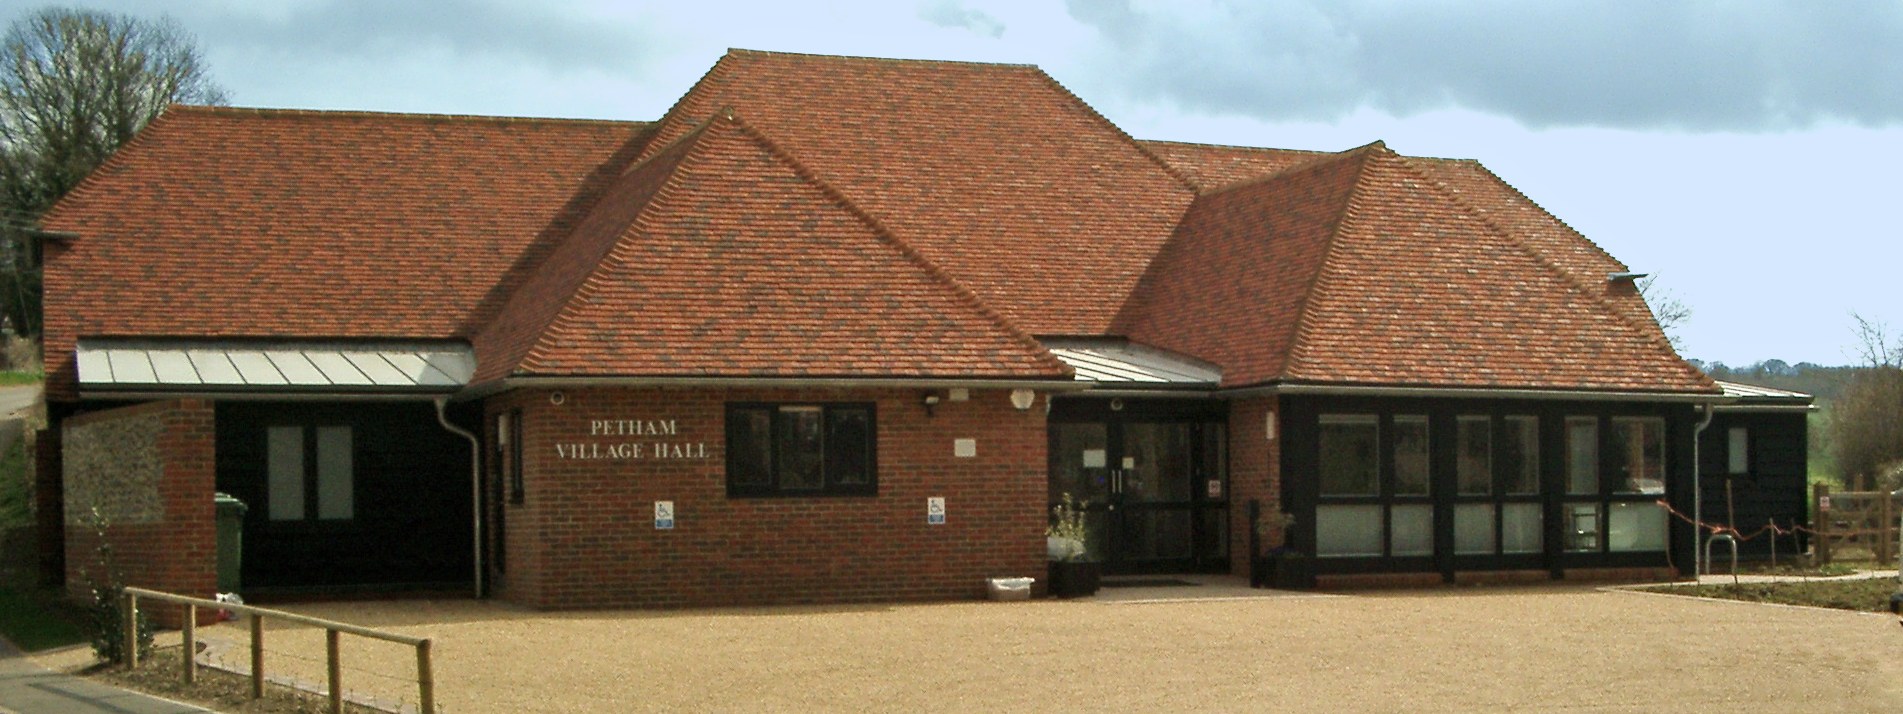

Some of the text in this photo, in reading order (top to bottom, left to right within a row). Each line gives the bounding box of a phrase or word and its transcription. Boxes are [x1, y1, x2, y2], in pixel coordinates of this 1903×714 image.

[591, 420, 676, 436] PETHAM
[556, 443, 710, 459] VILLAGE HALL
